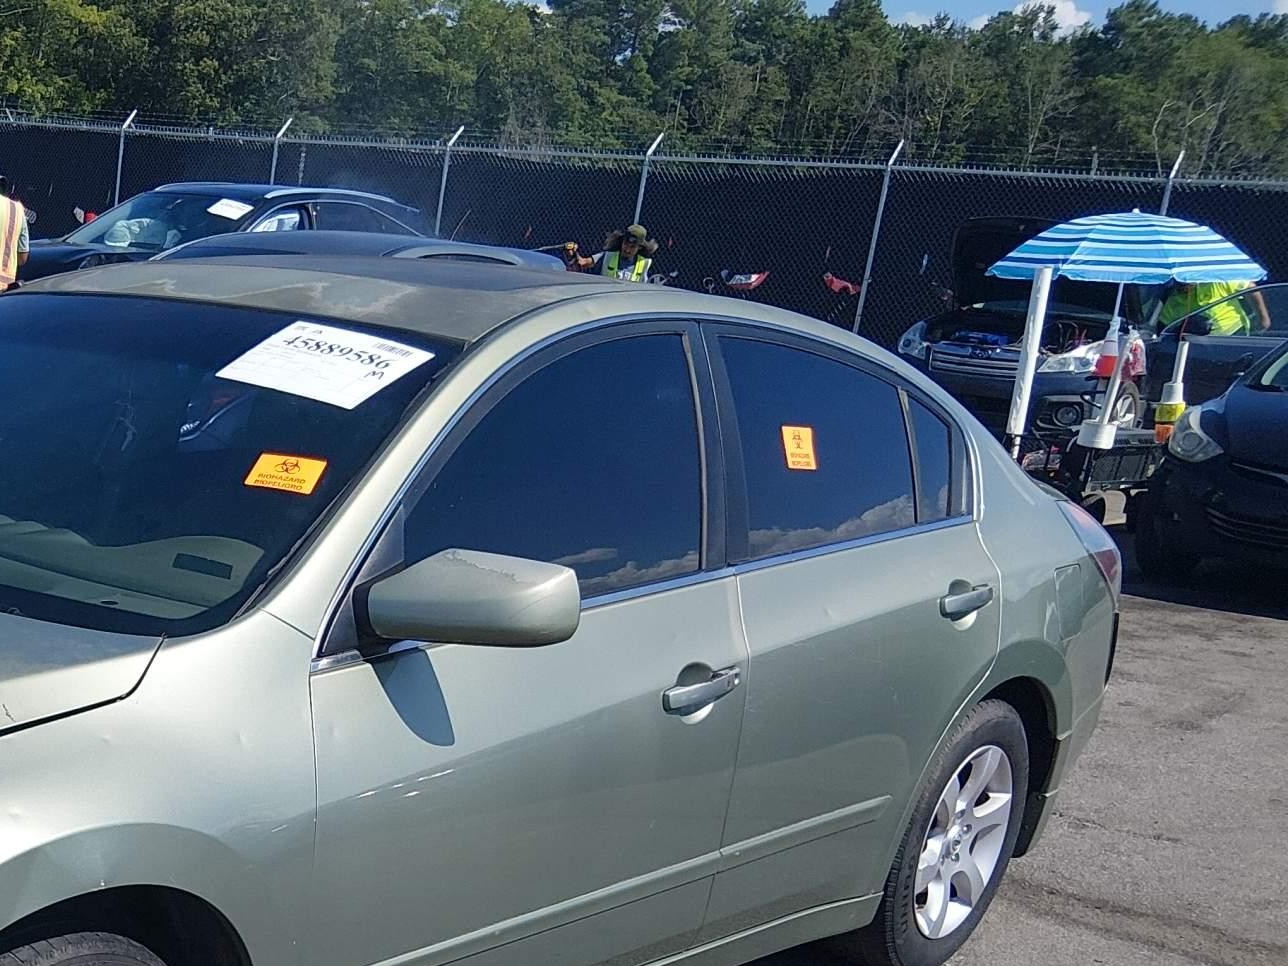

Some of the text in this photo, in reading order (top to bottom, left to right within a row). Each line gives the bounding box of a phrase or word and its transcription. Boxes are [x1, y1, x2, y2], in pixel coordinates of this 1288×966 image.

[283, 335, 392, 369] 45889586
[257, 473, 306, 484] BIOHAZARD
[253, 479, 303, 491] BIOPELIGRO
